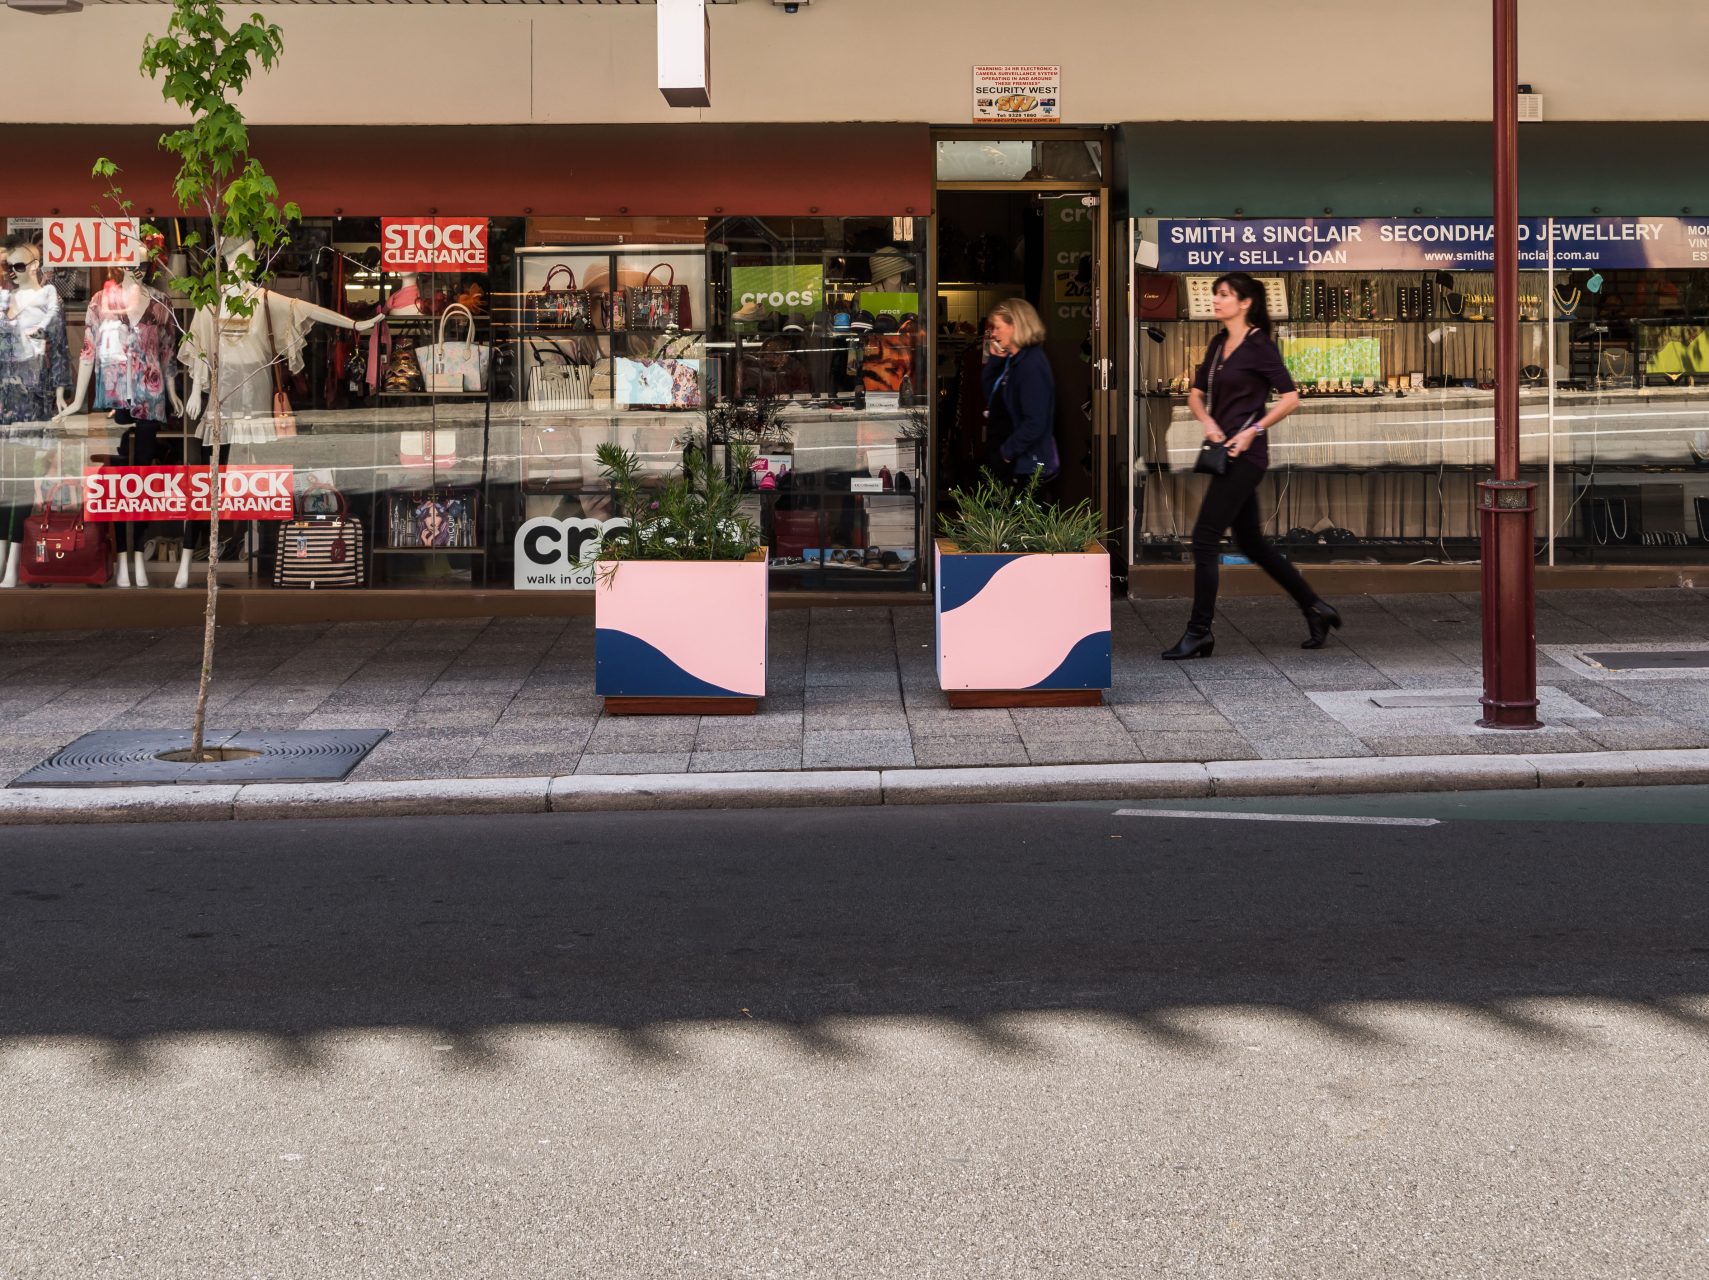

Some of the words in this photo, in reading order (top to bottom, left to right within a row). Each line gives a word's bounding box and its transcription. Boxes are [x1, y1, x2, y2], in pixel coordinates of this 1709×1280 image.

[975, 86, 1026, 94] SECURITY
[1028, 86, 1058, 94] WEST
[384, 224, 485, 250] STOCK
[1170, 226, 1235, 244] SMITH
[1241, 226, 1257, 244] &
[1263, 226, 1362, 243] SINCLAIR
[1380, 224, 1530, 241] SECONDHAD
[1535, 224, 1664, 241] JEWELLERY
[1687, 225, 1709, 236] MO
[48, 221, 135, 263] SALE
[1688, 238, 1709, 248] VIN
[384, 249, 486, 264] CLEARANCE
[1188, 250, 1225, 265] BUY
[1239, 250, 1284, 265] SELL
[1299, 250, 1347, 264] LOAN
[1692, 251, 1709, 261] ES
[740, 290, 814, 307] crocs
[86, 473, 185, 499] STOCK
[191, 472, 291, 498] STOCK
[86, 498, 187, 513] CLEARANCE
[190, 497, 291, 512] CLEARANCE
[526, 573, 556, 584] walk
[560, 573, 572, 584] in
